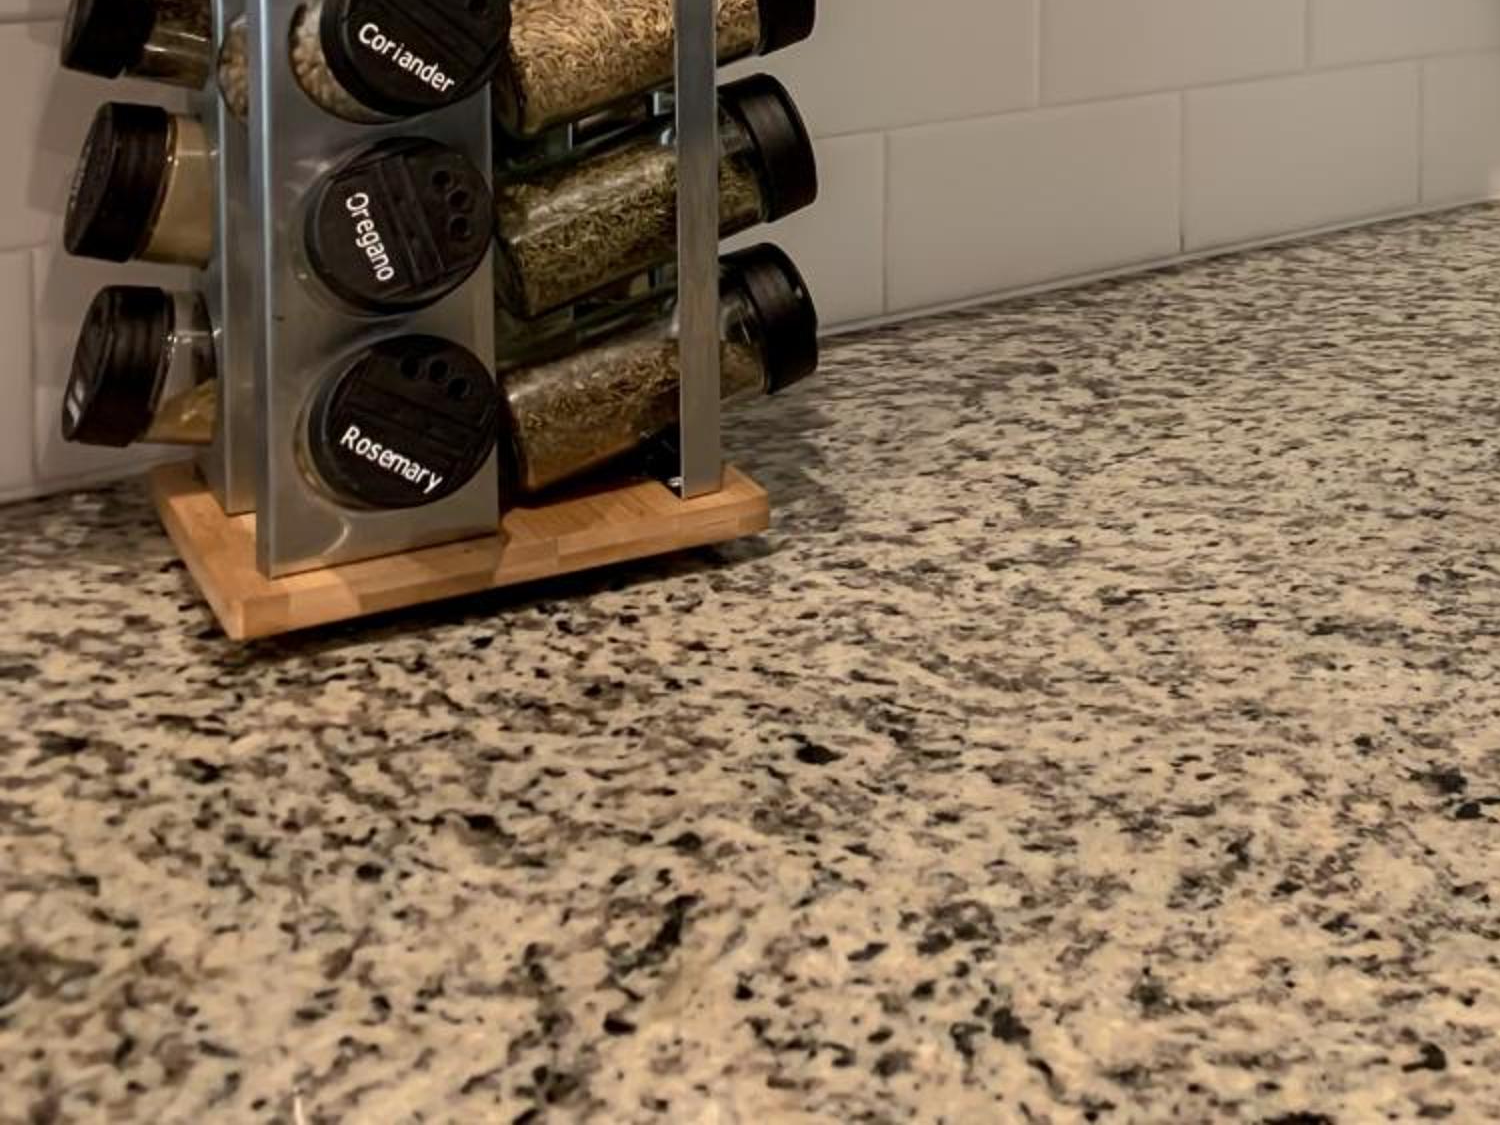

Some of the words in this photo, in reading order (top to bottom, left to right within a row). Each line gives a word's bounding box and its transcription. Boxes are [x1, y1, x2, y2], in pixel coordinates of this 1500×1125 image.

[358, 22, 455, 92] Coriander
[345, 192, 395, 281] Oregano
[340, 424, 443, 495] Rosemary
